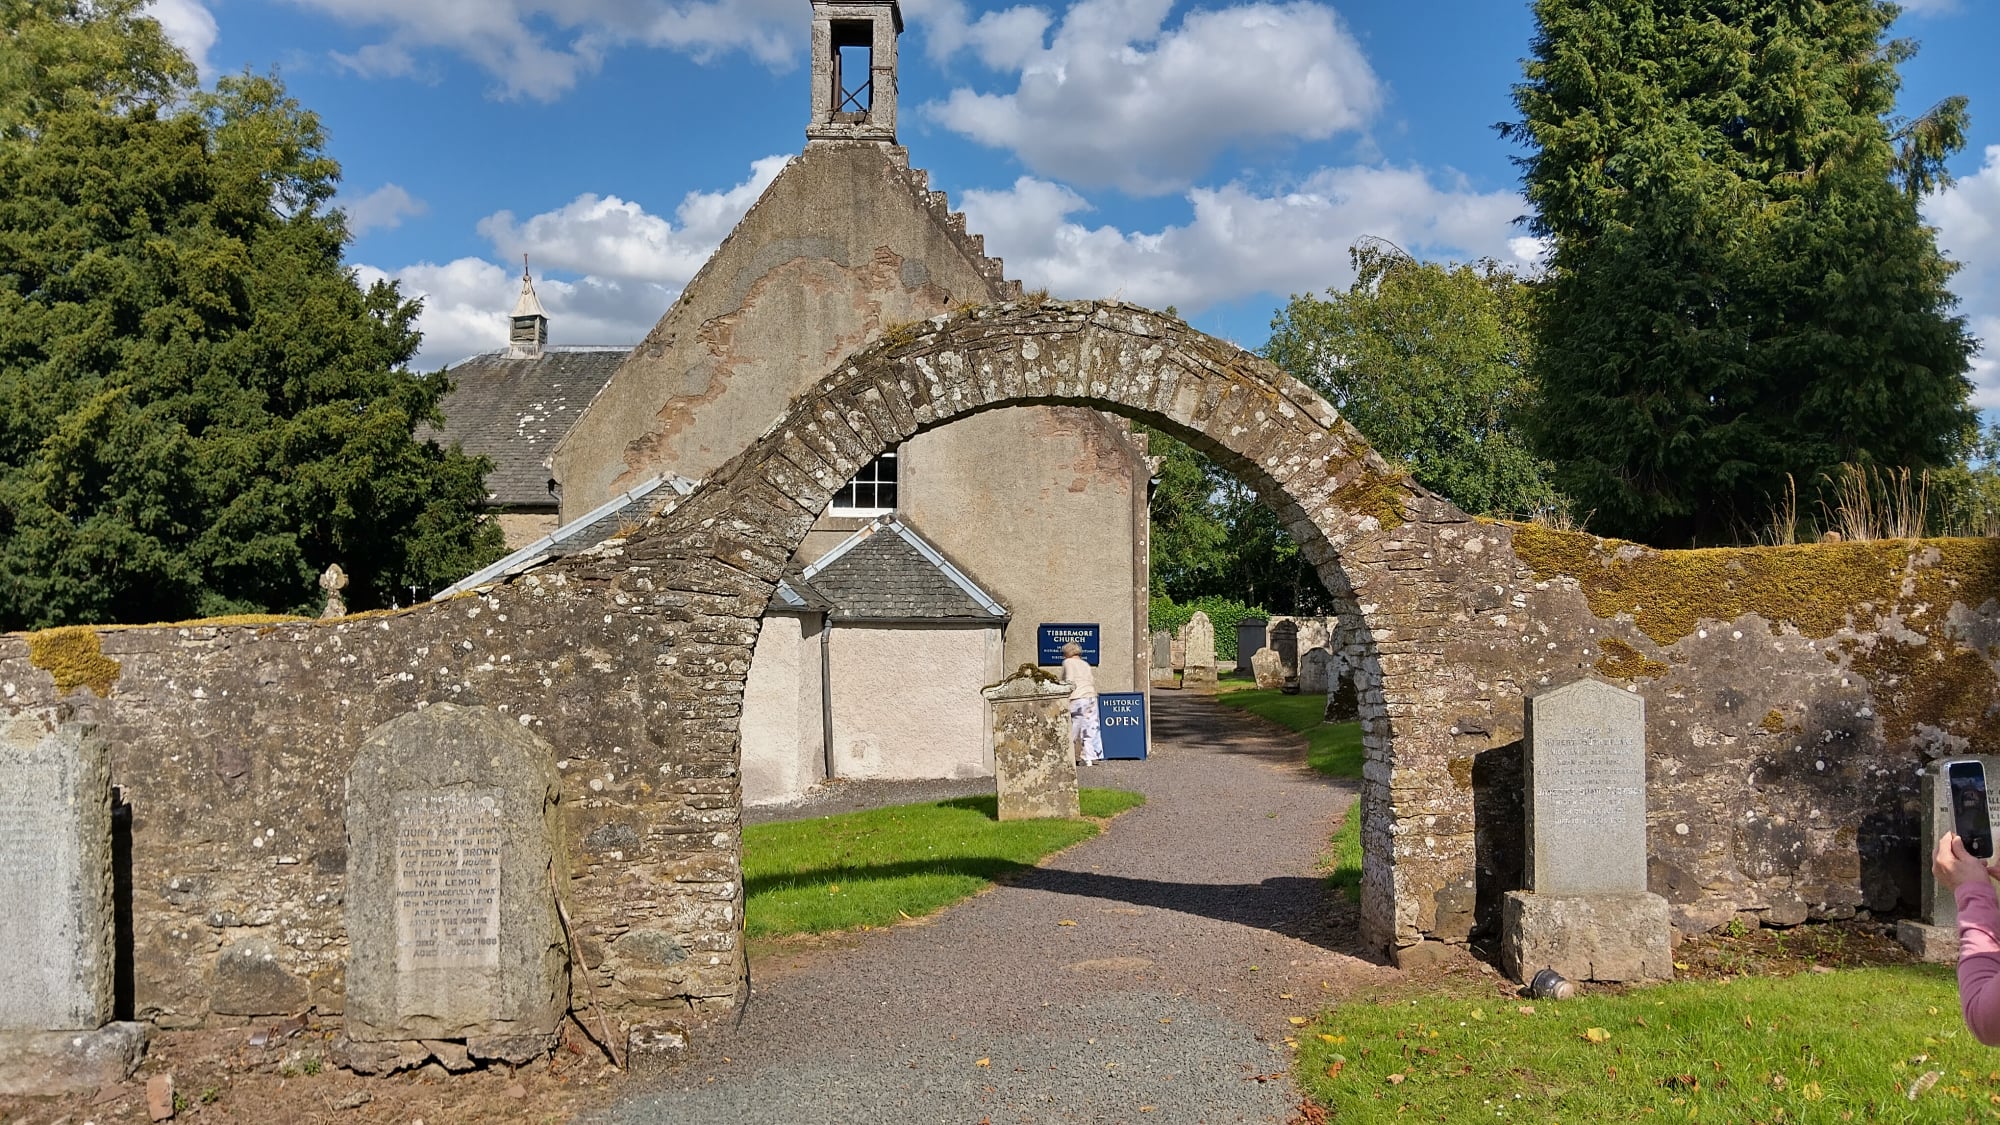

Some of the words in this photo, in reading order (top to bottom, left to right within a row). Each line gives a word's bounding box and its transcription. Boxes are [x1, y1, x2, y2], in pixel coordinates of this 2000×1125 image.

[1105, 716, 1139, 726] OPEN
[400, 849, 442, 858] ALFRED
[446, 848, 458, 857] W.
[463, 848, 499, 857] BROWN
[403, 869, 442, 877] BELOVED
[485, 868, 496, 876] OF
[415, 880, 437, 888] NAN
[445, 878, 481, 886] LEMON
